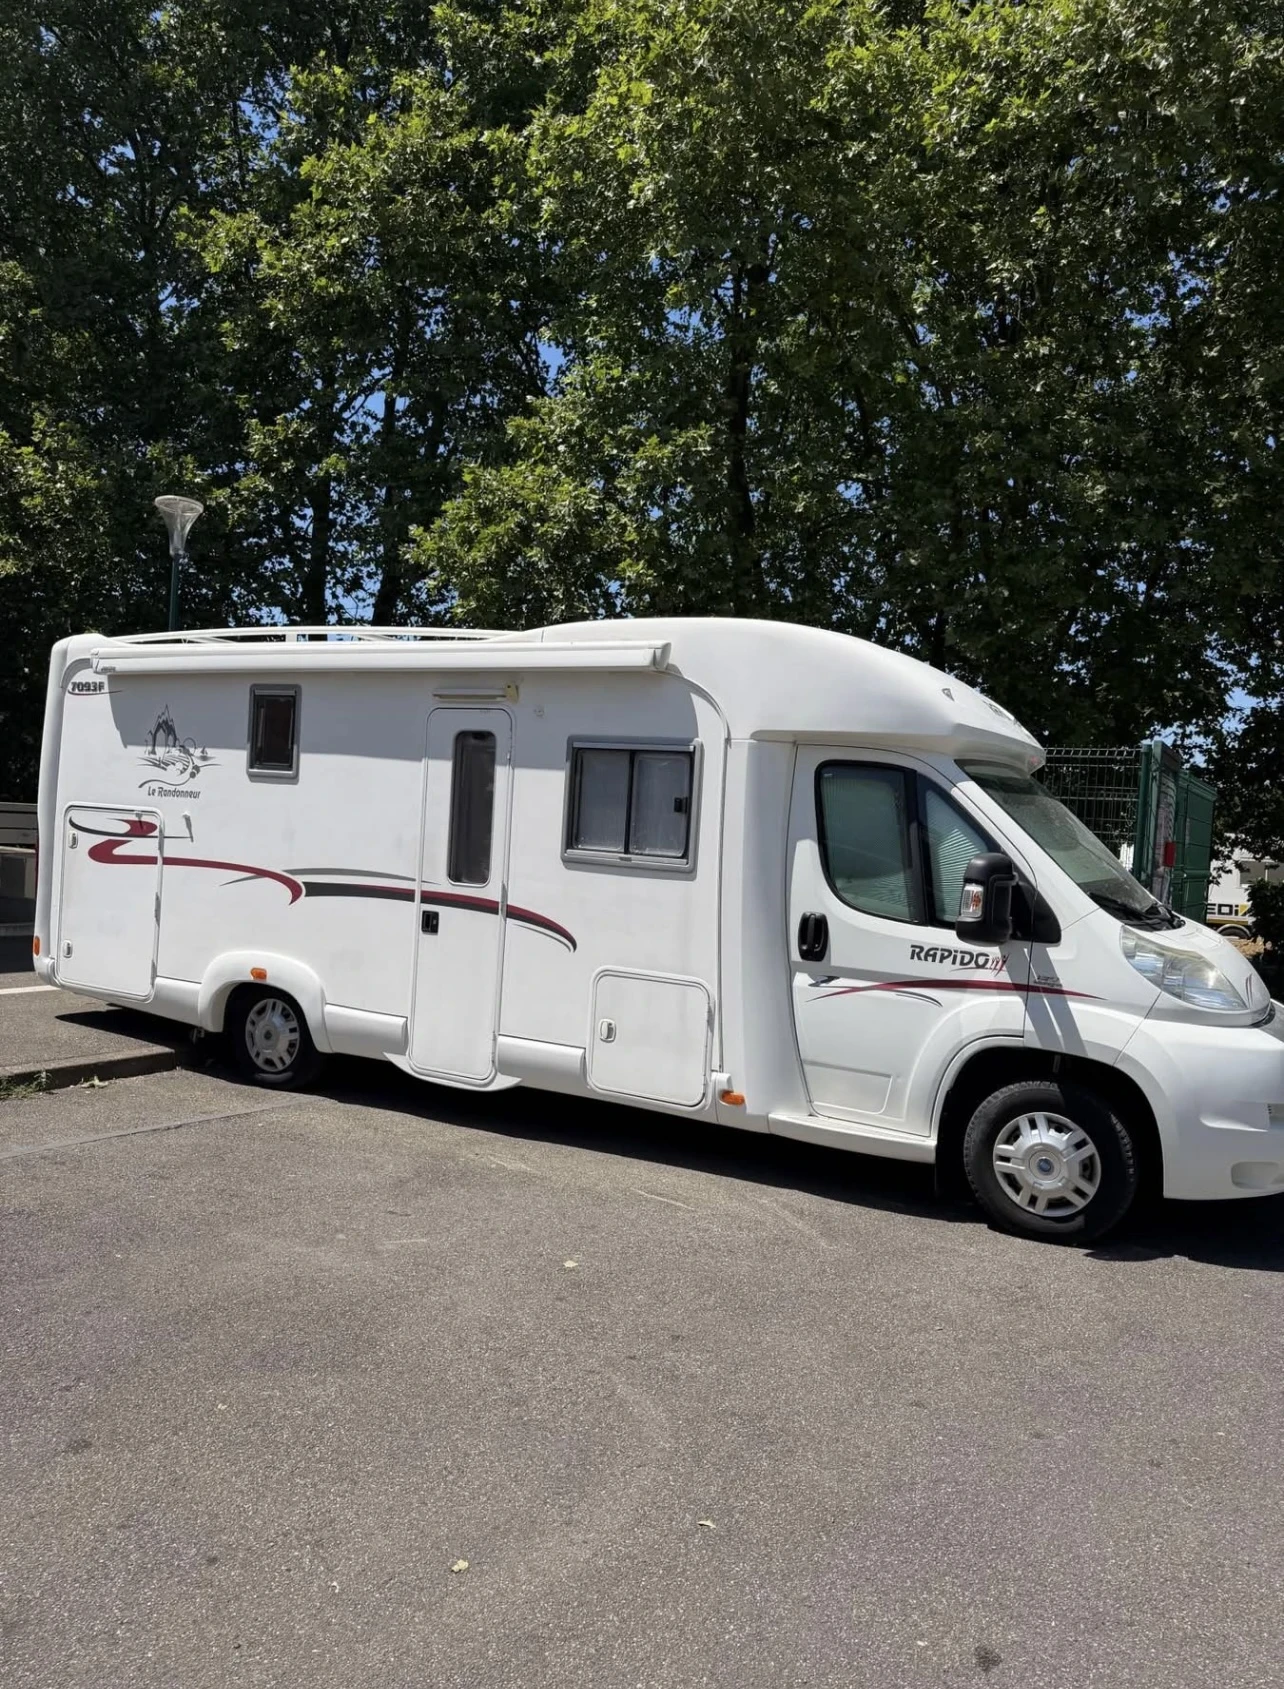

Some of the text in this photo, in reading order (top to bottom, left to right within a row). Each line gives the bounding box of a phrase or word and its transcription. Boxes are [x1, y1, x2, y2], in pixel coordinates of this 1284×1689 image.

[71, 681, 105, 692] 7093F
[147, 786, 201, 799] Le Randonneur
